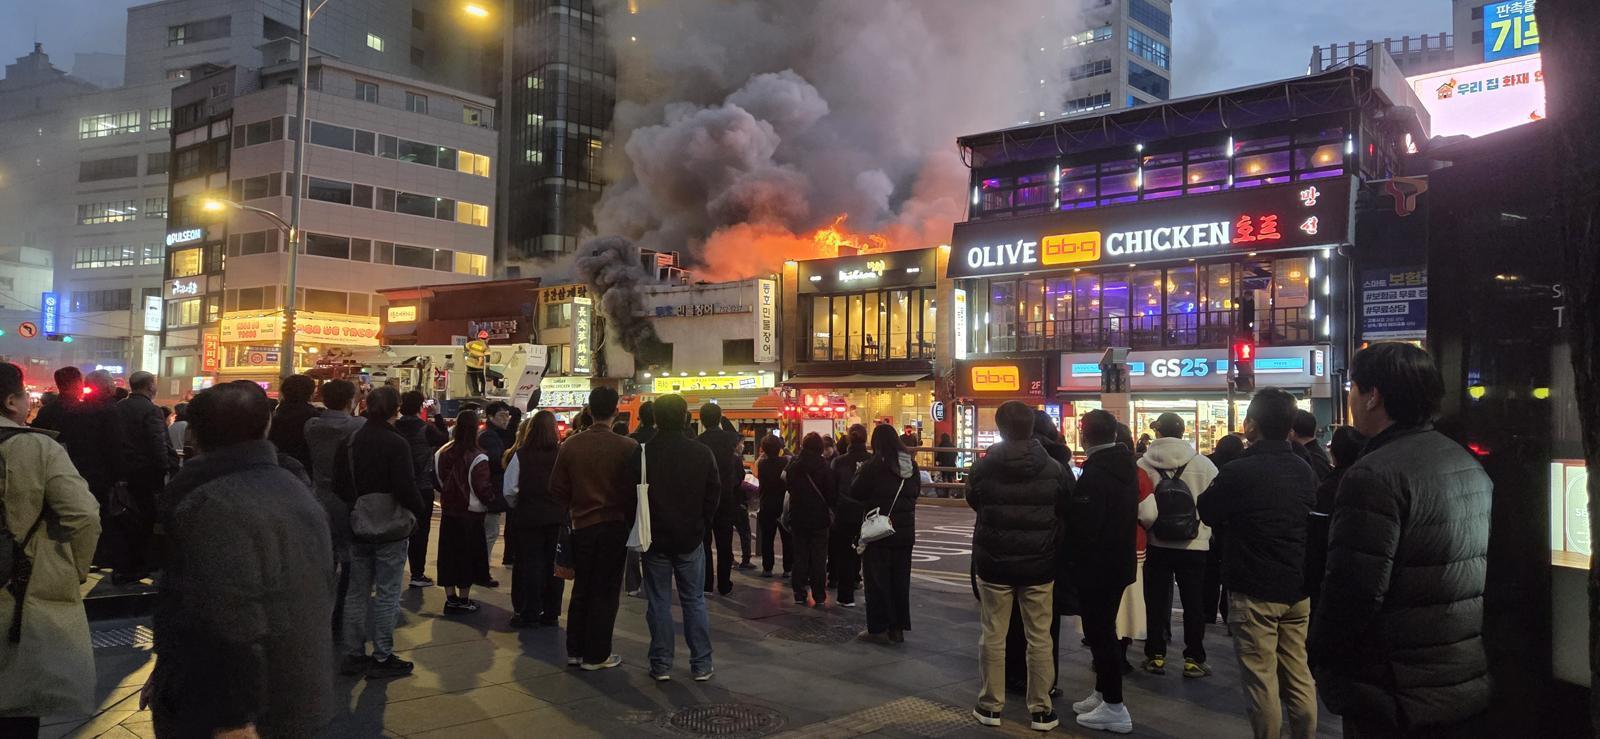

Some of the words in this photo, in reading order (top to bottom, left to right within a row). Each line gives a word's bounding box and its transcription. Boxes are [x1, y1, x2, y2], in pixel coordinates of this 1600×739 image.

[1457, 80, 1483, 95] 우리
[1486, 77, 1499, 91] 집
[1502, 72, 1530, 88] 화재
[1300, 185, 1320, 235] 만선
[968, 239, 1037, 268] OLIVE
[1106, 220, 1231, 256] CHICKEN
[762, 283, 772, 355] 동호민물장어
[1151, 358, 1209, 378] GS25
